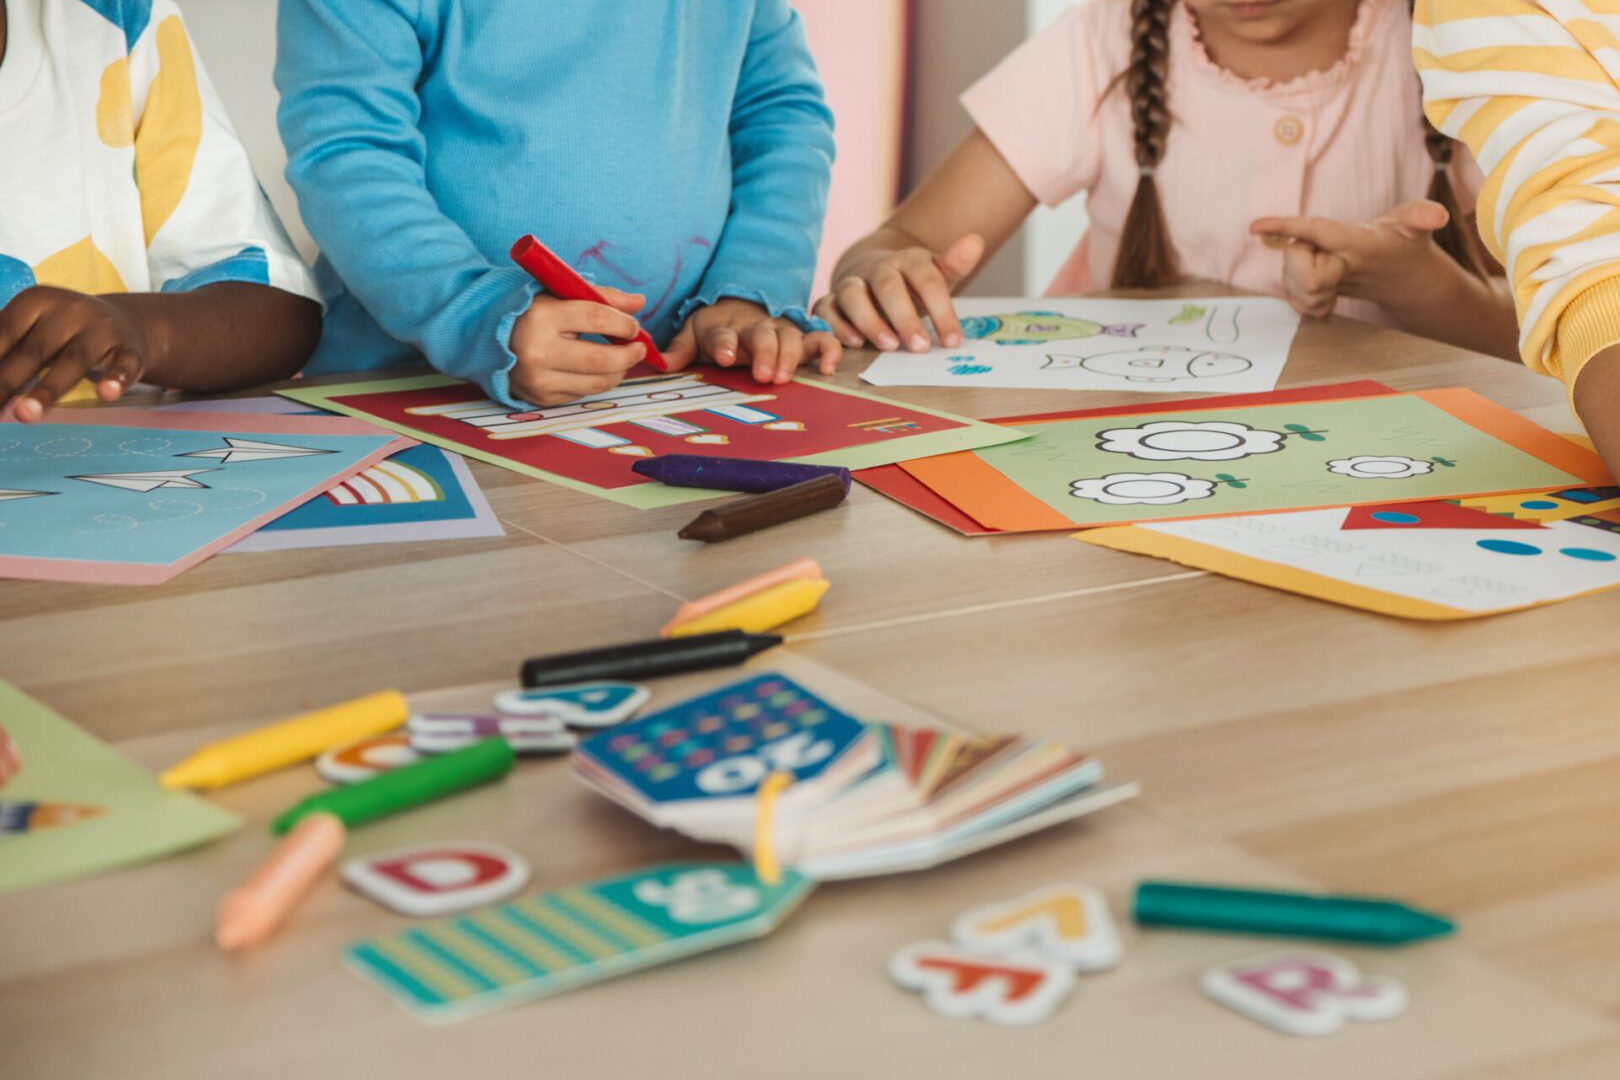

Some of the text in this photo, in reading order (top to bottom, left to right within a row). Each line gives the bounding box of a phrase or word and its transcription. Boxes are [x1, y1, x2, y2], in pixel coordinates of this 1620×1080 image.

[368, 849, 511, 894] D
[914, 956, 1047, 1003] F
[1231, 957, 1383, 1013] R
